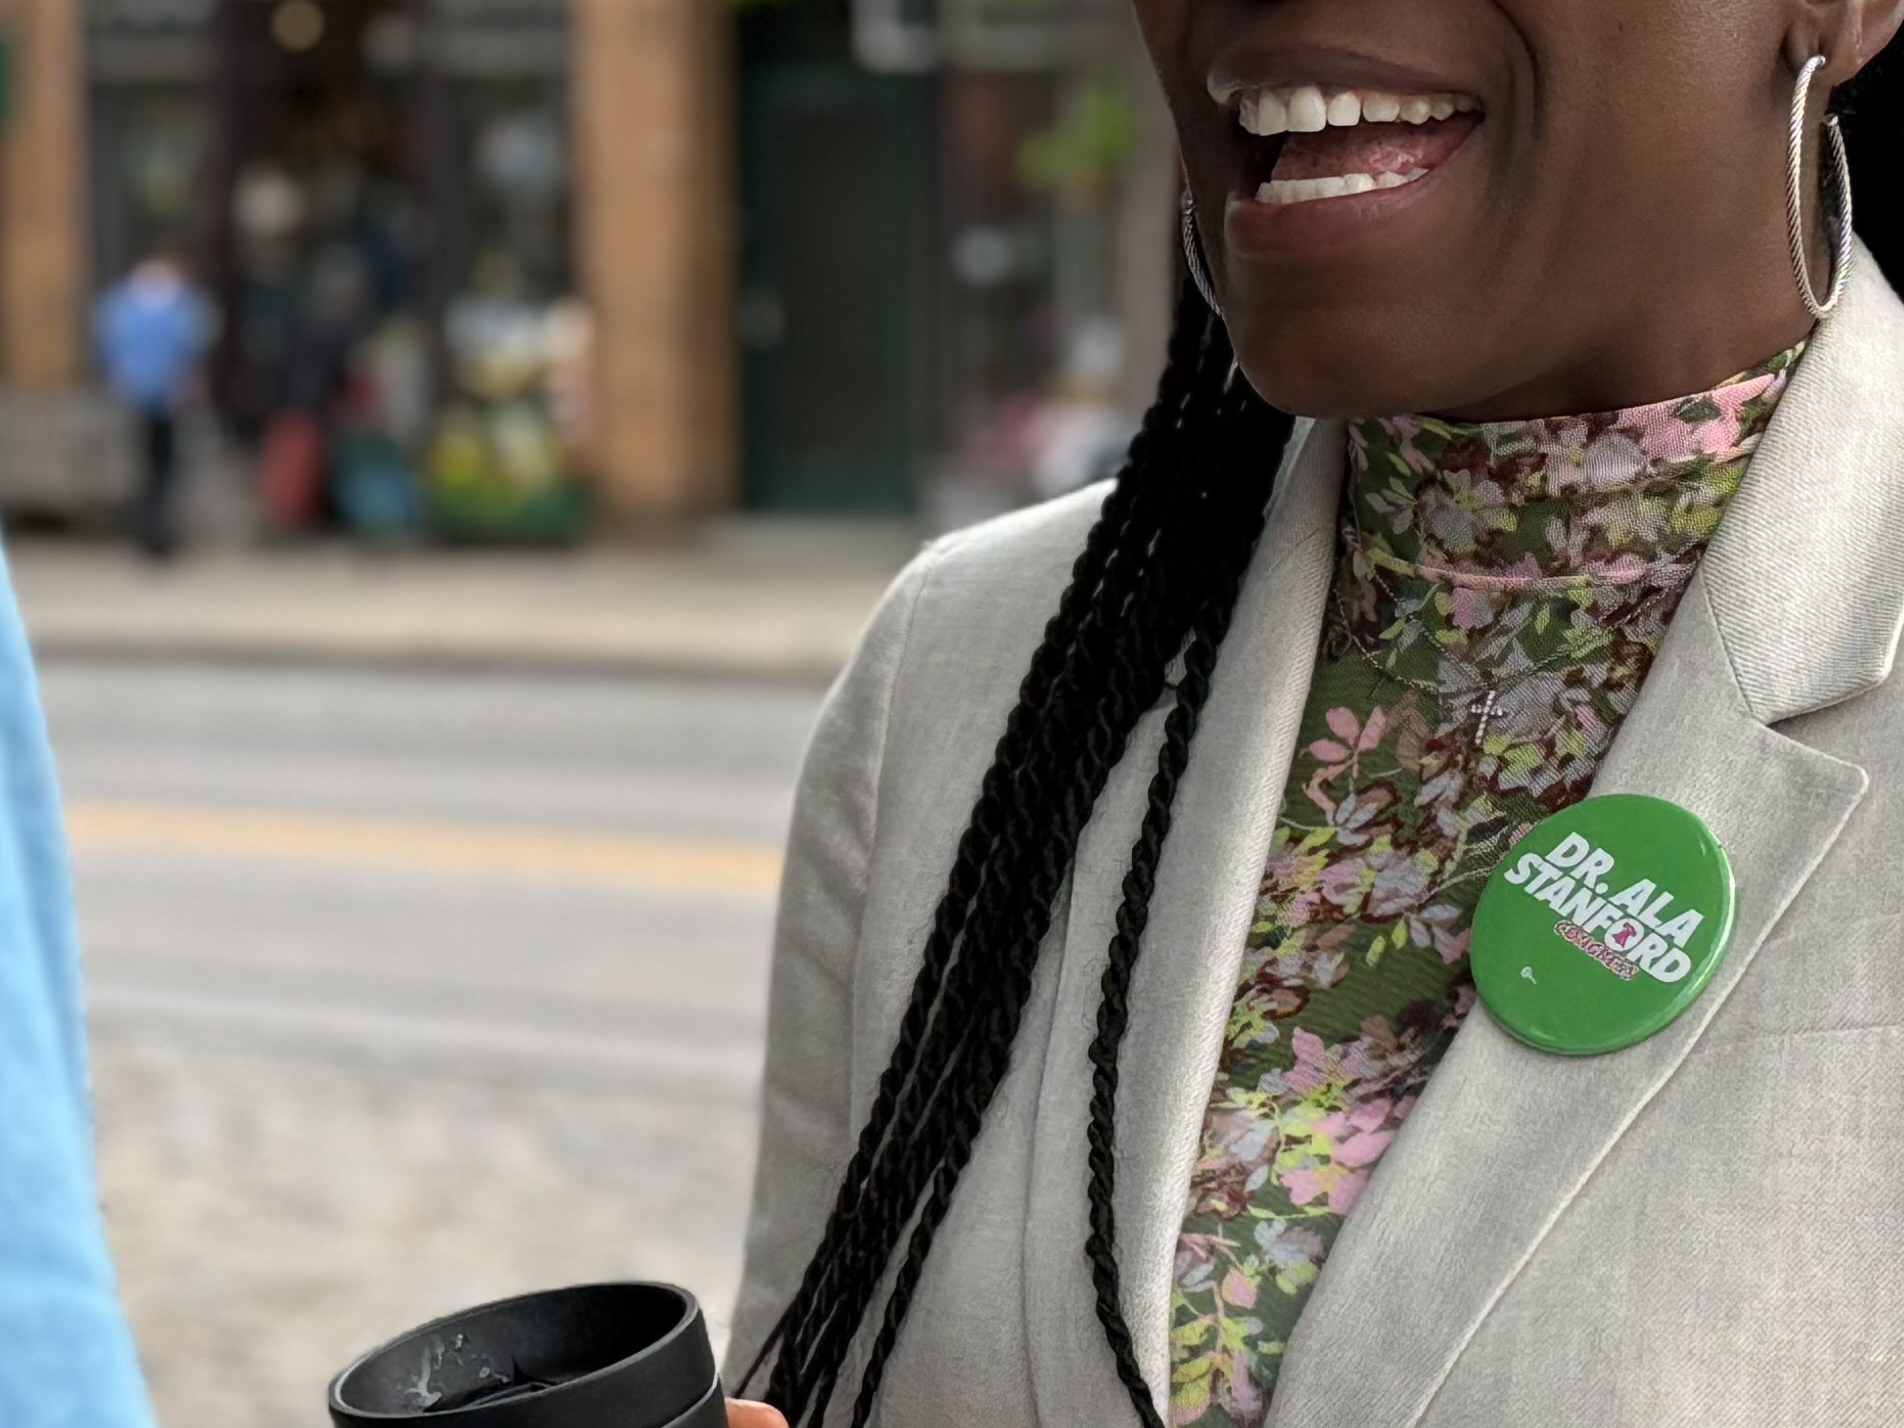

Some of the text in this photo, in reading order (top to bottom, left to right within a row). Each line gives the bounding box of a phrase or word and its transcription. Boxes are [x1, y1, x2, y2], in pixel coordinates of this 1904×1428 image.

[1504, 853, 1692, 983] STANFORD
[1545, 832, 1705, 948] DR. ALA
